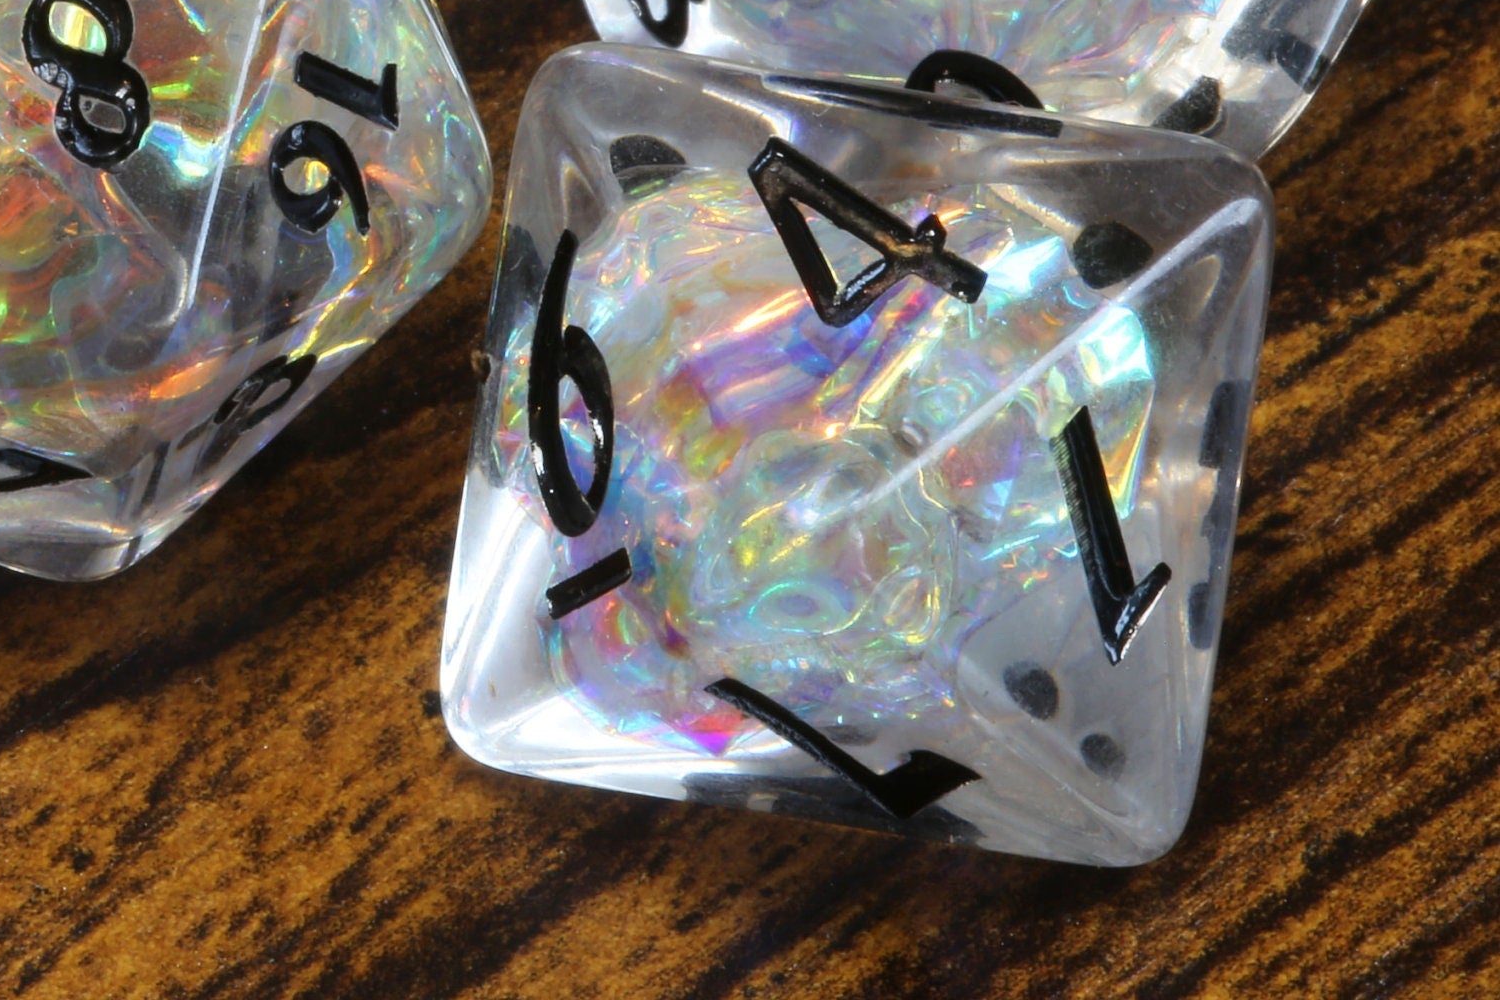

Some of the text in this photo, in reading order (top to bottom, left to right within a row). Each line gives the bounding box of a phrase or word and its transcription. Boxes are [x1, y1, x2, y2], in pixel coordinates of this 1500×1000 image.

[269, 51, 399, 236] 16
[748, 137, 988, 328] 4
[528, 230, 613, 537] 6
